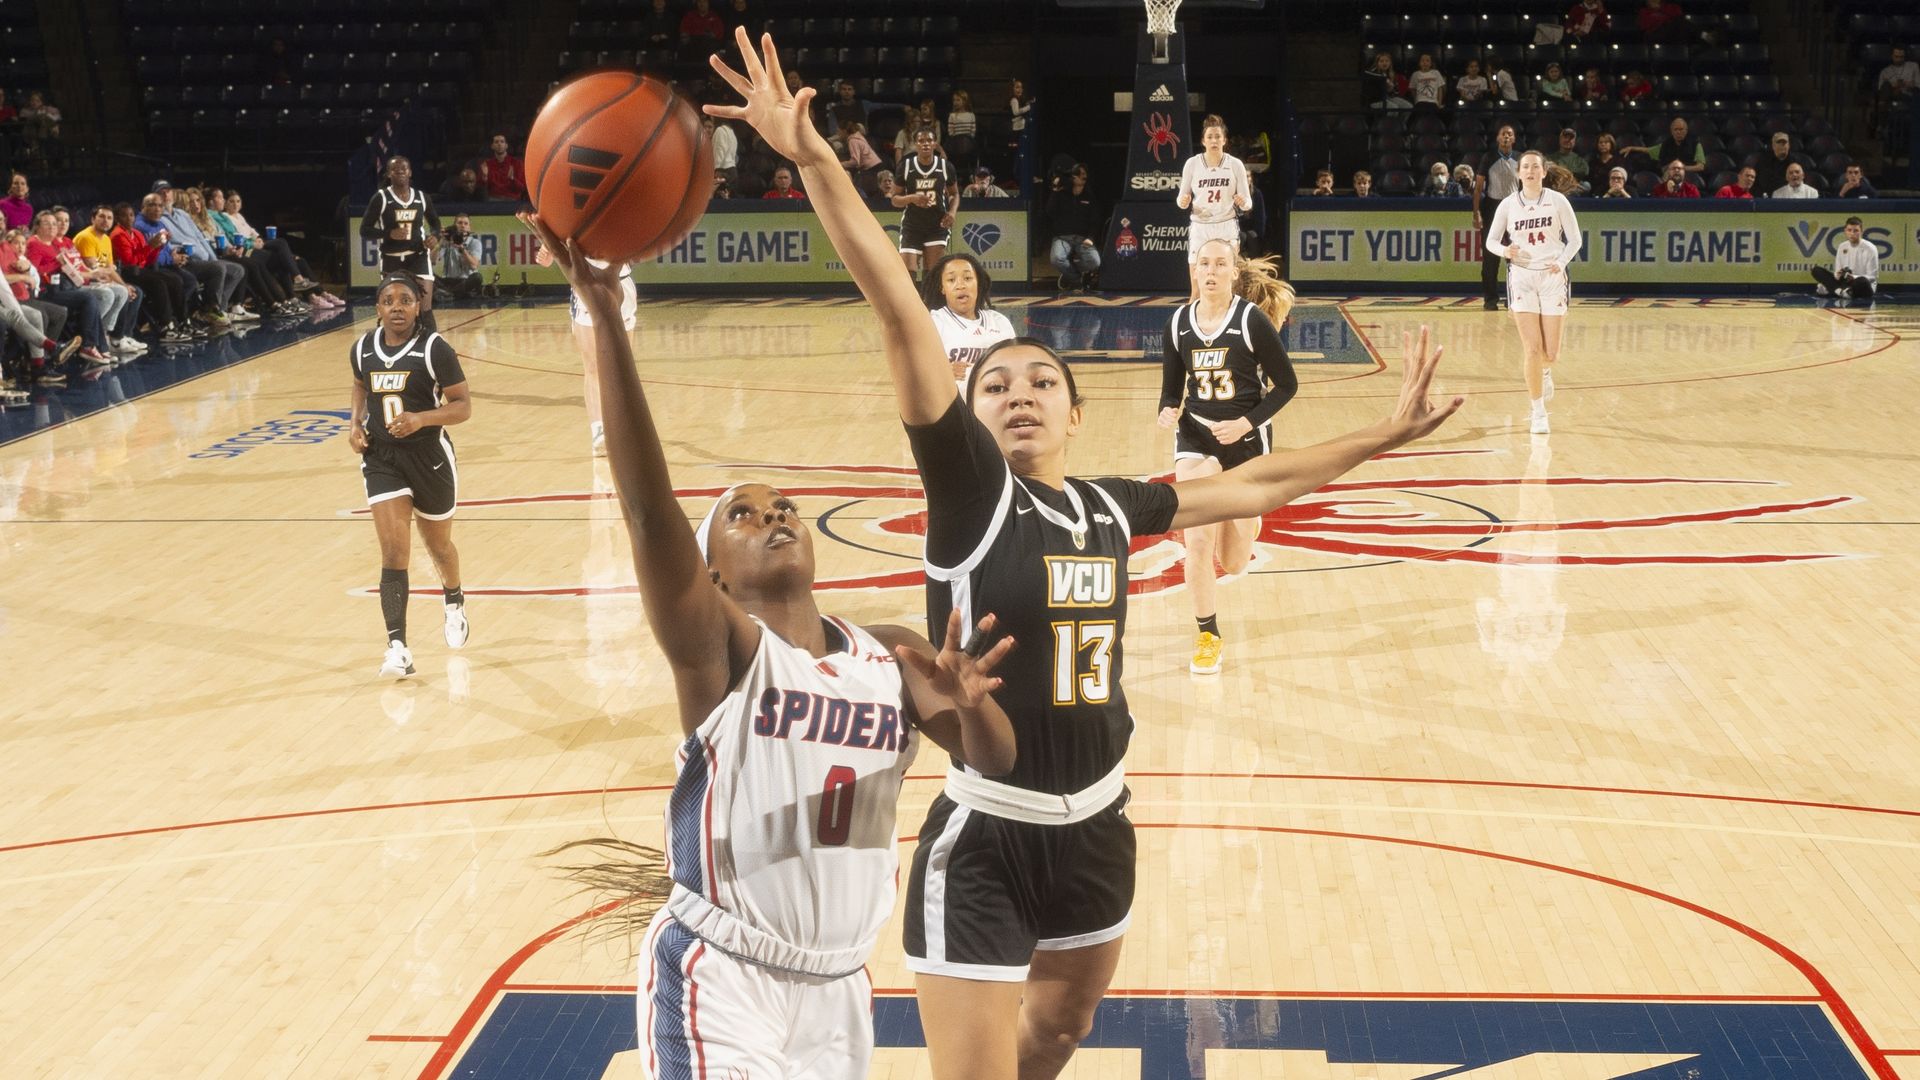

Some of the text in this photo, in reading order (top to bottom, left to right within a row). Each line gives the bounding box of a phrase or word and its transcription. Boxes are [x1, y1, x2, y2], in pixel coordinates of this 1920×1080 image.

[915, 179, 937, 189] VCU
[1198, 178, 1230, 188] SPIDERS
[1207, 190, 1221, 203] 24
[395, 210, 417, 221] VCU
[1514, 216, 1553, 231] SPIDERS
[717, 231, 810, 263] GAME!
[1300, 230, 1355, 262] GET
[1365, 230, 1442, 262] YOUR
[1528, 231, 1546, 246] 44
[1601, 230, 1657, 262] THE
[1667, 231, 1761, 263] GAME!
[1193, 350, 1227, 369] VCU
[372, 373, 409, 391] VCU
[1194, 370, 1236, 401] 33
[1050, 560, 1115, 605] VCU
[1051, 619, 1117, 706] 13
[817, 765, 857, 846] 0
